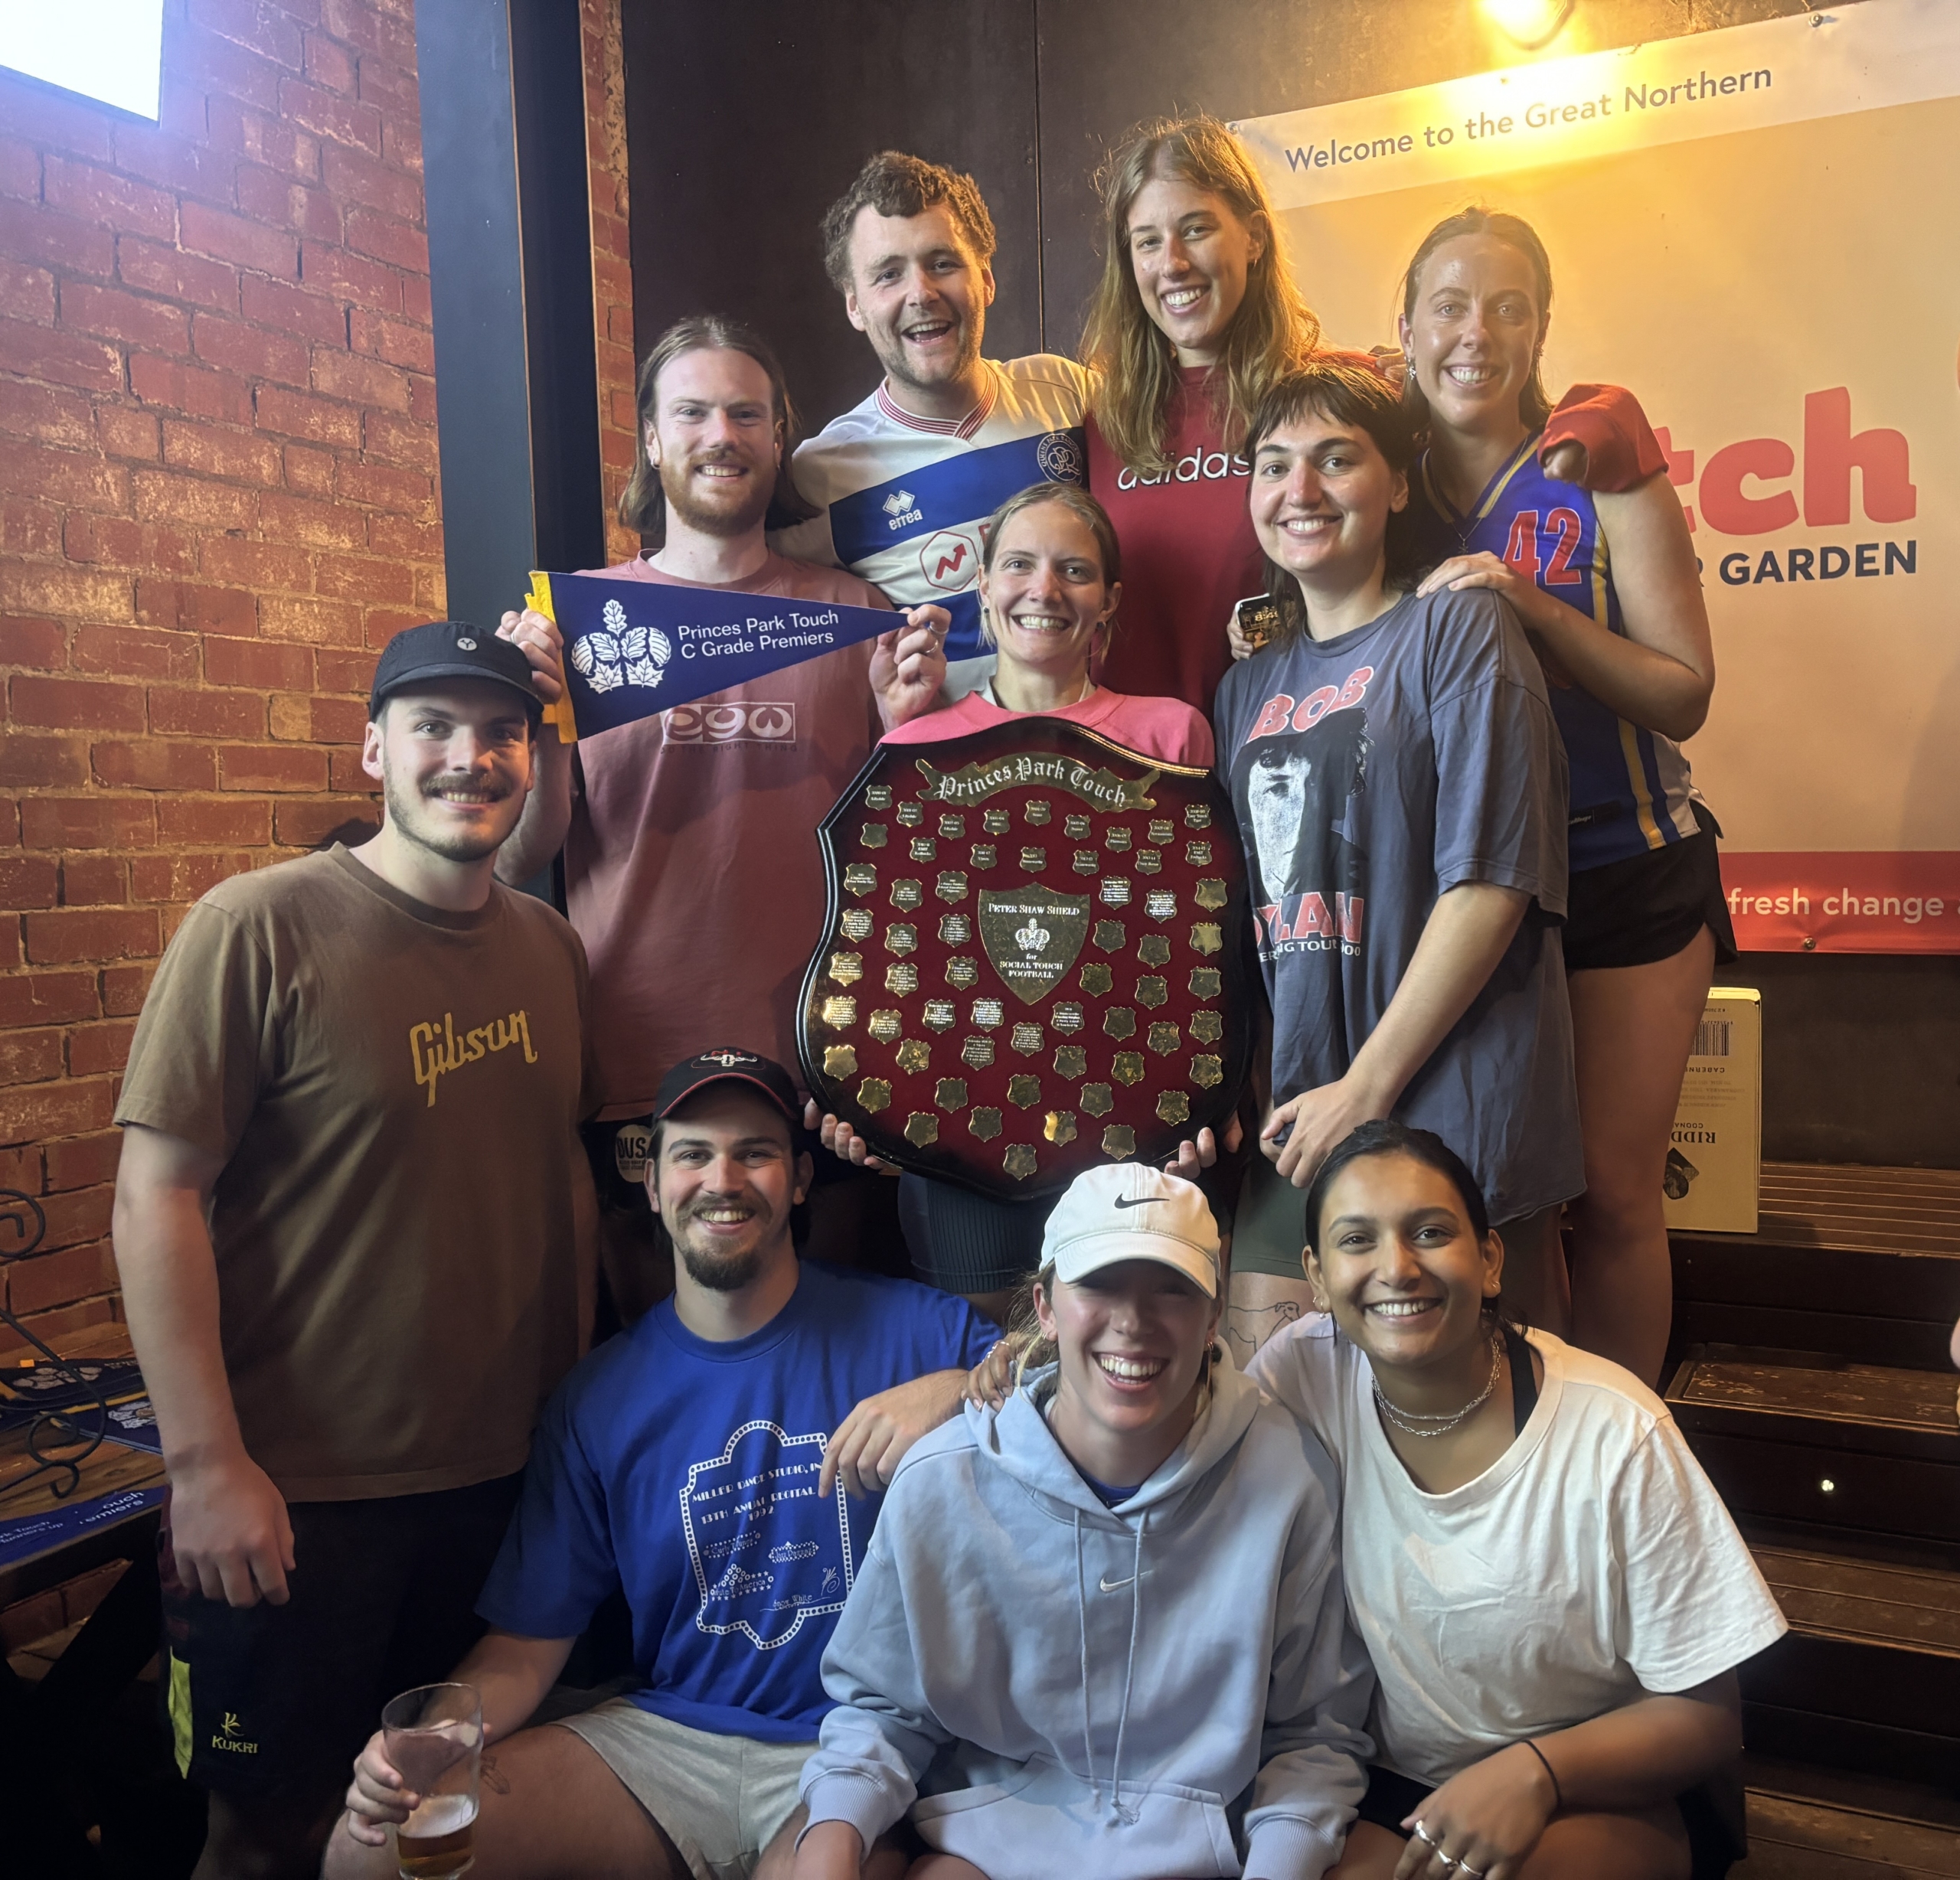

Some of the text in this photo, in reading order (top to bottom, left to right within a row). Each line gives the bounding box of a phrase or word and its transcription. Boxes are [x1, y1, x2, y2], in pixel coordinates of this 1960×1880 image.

[1285, 68, 1773, 173] Welcome to the Great Northern
[888, 509, 923, 530] errea
[1501, 507, 1582, 586] 42
[1719, 540, 1917, 586] GARDEN
[678, 609, 839, 641] Princes Park Touch
[681, 632, 835, 659] C Grade Premiers
[1249, 665, 1374, 744] BOB
[712, 742, 749, 753] RIGHT
[758, 743, 798, 752] THING
[933, 756, 1127, 808] Princes Park Touch
[988, 902, 1080, 916] PETER SHAW SHIELD
[1728, 887, 1945, 925] fresh change
[1297, 940, 1338, 951] TOUR
[999, 961, 1063, 971] SOCIAL TOUCH
[1008, 970, 1054, 979] FOOTBALL
[410, 1010, 537, 1108] Gibson
[1671, 1131, 1716, 1144] RIDD
[692, 1483, 733, 1503] MILLER
[737, 1473, 765, 1490] DANCE
[770, 1486, 816, 1502] RECITAL
[103, 1491, 145, 1510] ouch
[747, 1505, 775, 1522] 1992
[211, 1735, 258, 1753] KUKRI
